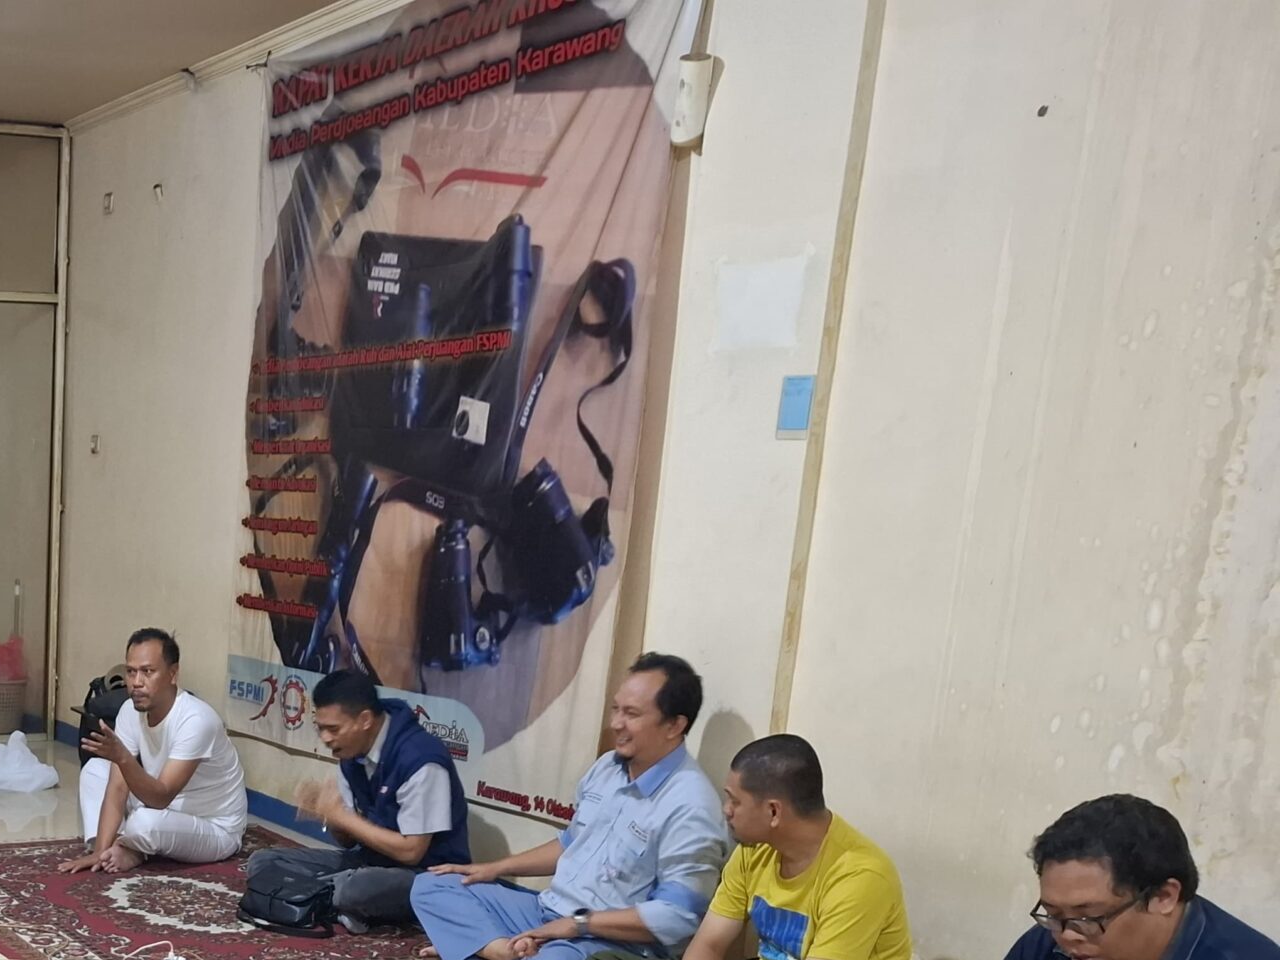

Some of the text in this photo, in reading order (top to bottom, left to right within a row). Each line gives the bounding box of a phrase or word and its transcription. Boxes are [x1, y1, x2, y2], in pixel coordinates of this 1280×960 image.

[334, 34, 400, 94] KERJA
[401, 0, 501, 68] DAERAH
[311, 93, 411, 146] Perdjoeangan
[413, 58, 511, 112] Kabupaten
[516, 19, 626, 79] Karawang
[418, 338, 474, 360] Perjuangan
[476, 331, 512, 351] FSPMI
[229, 679, 265, 702] FSPMI
